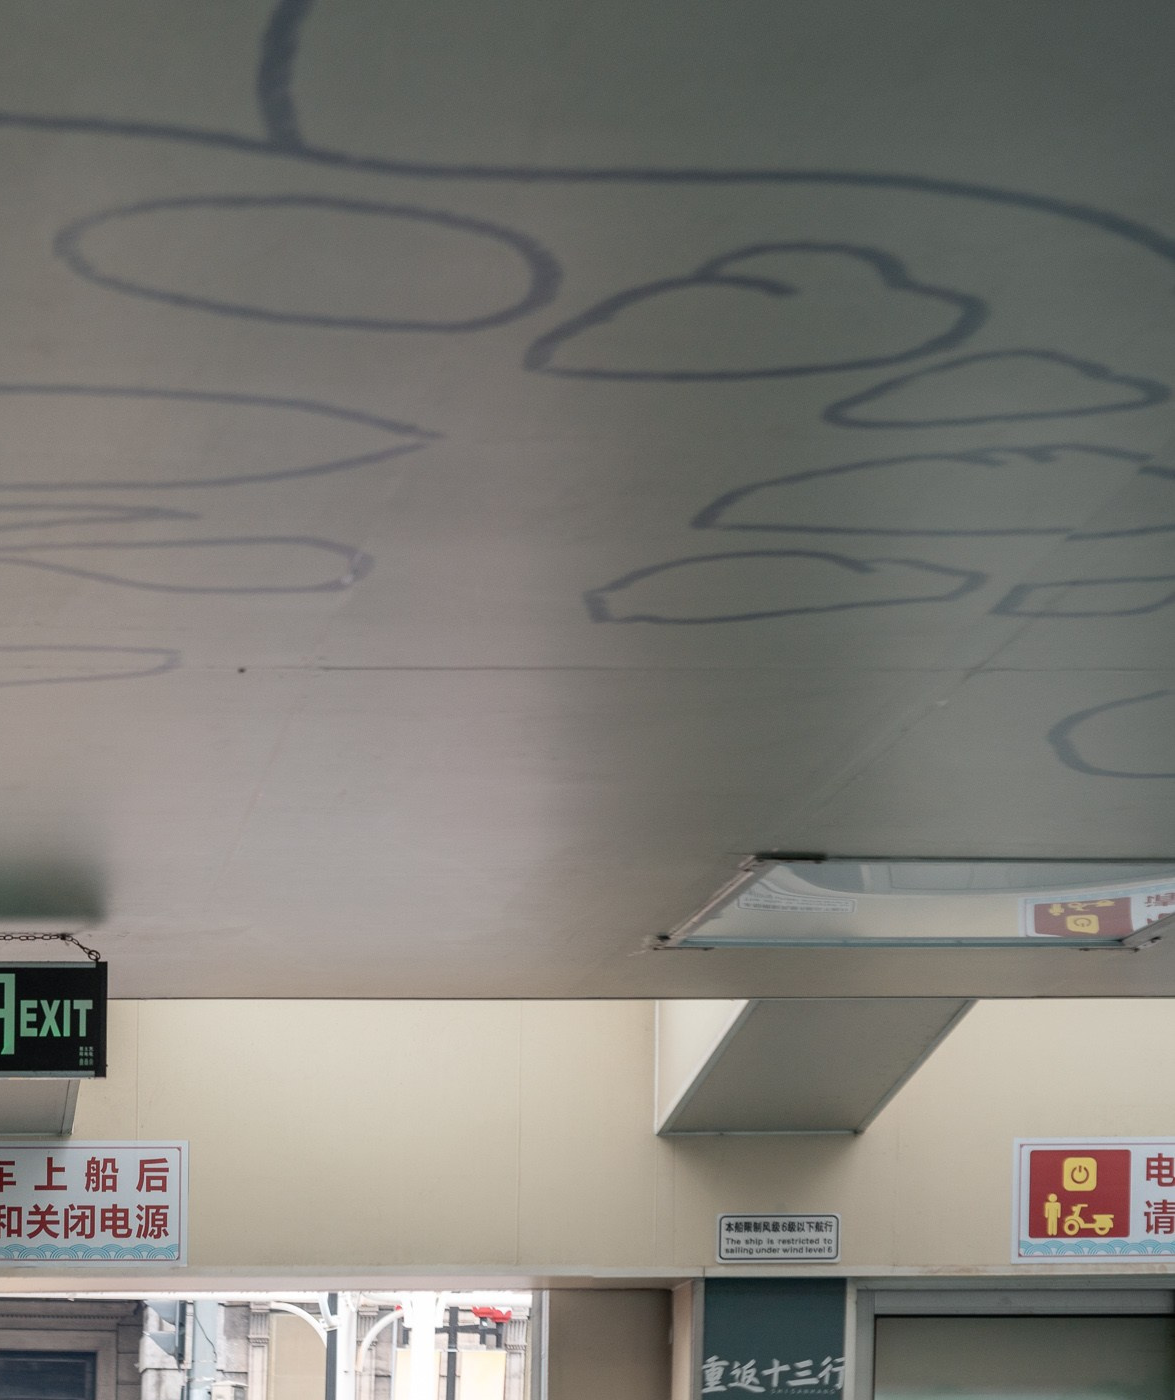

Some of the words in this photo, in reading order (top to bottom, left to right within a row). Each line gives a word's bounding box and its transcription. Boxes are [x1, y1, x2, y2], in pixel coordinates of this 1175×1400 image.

[20, 1000, 93, 1037] EXIT
[725, 1247, 754, 1256] sailing
[755, 1246, 780, 1255] under
[782, 1246, 804, 1255] wind
[806, 1246, 826, 1255] level
[827, 1246, 833, 1254] 6
[726, 1238, 742, 1246] The
[744, 1237, 764, 1247] ship
[767, 1237, 775, 1246] is
[777, 1237, 820, 1246] restricted
[824, 1238, 833, 1246] to
[702, 1355, 845, 1393] 重返十三行
